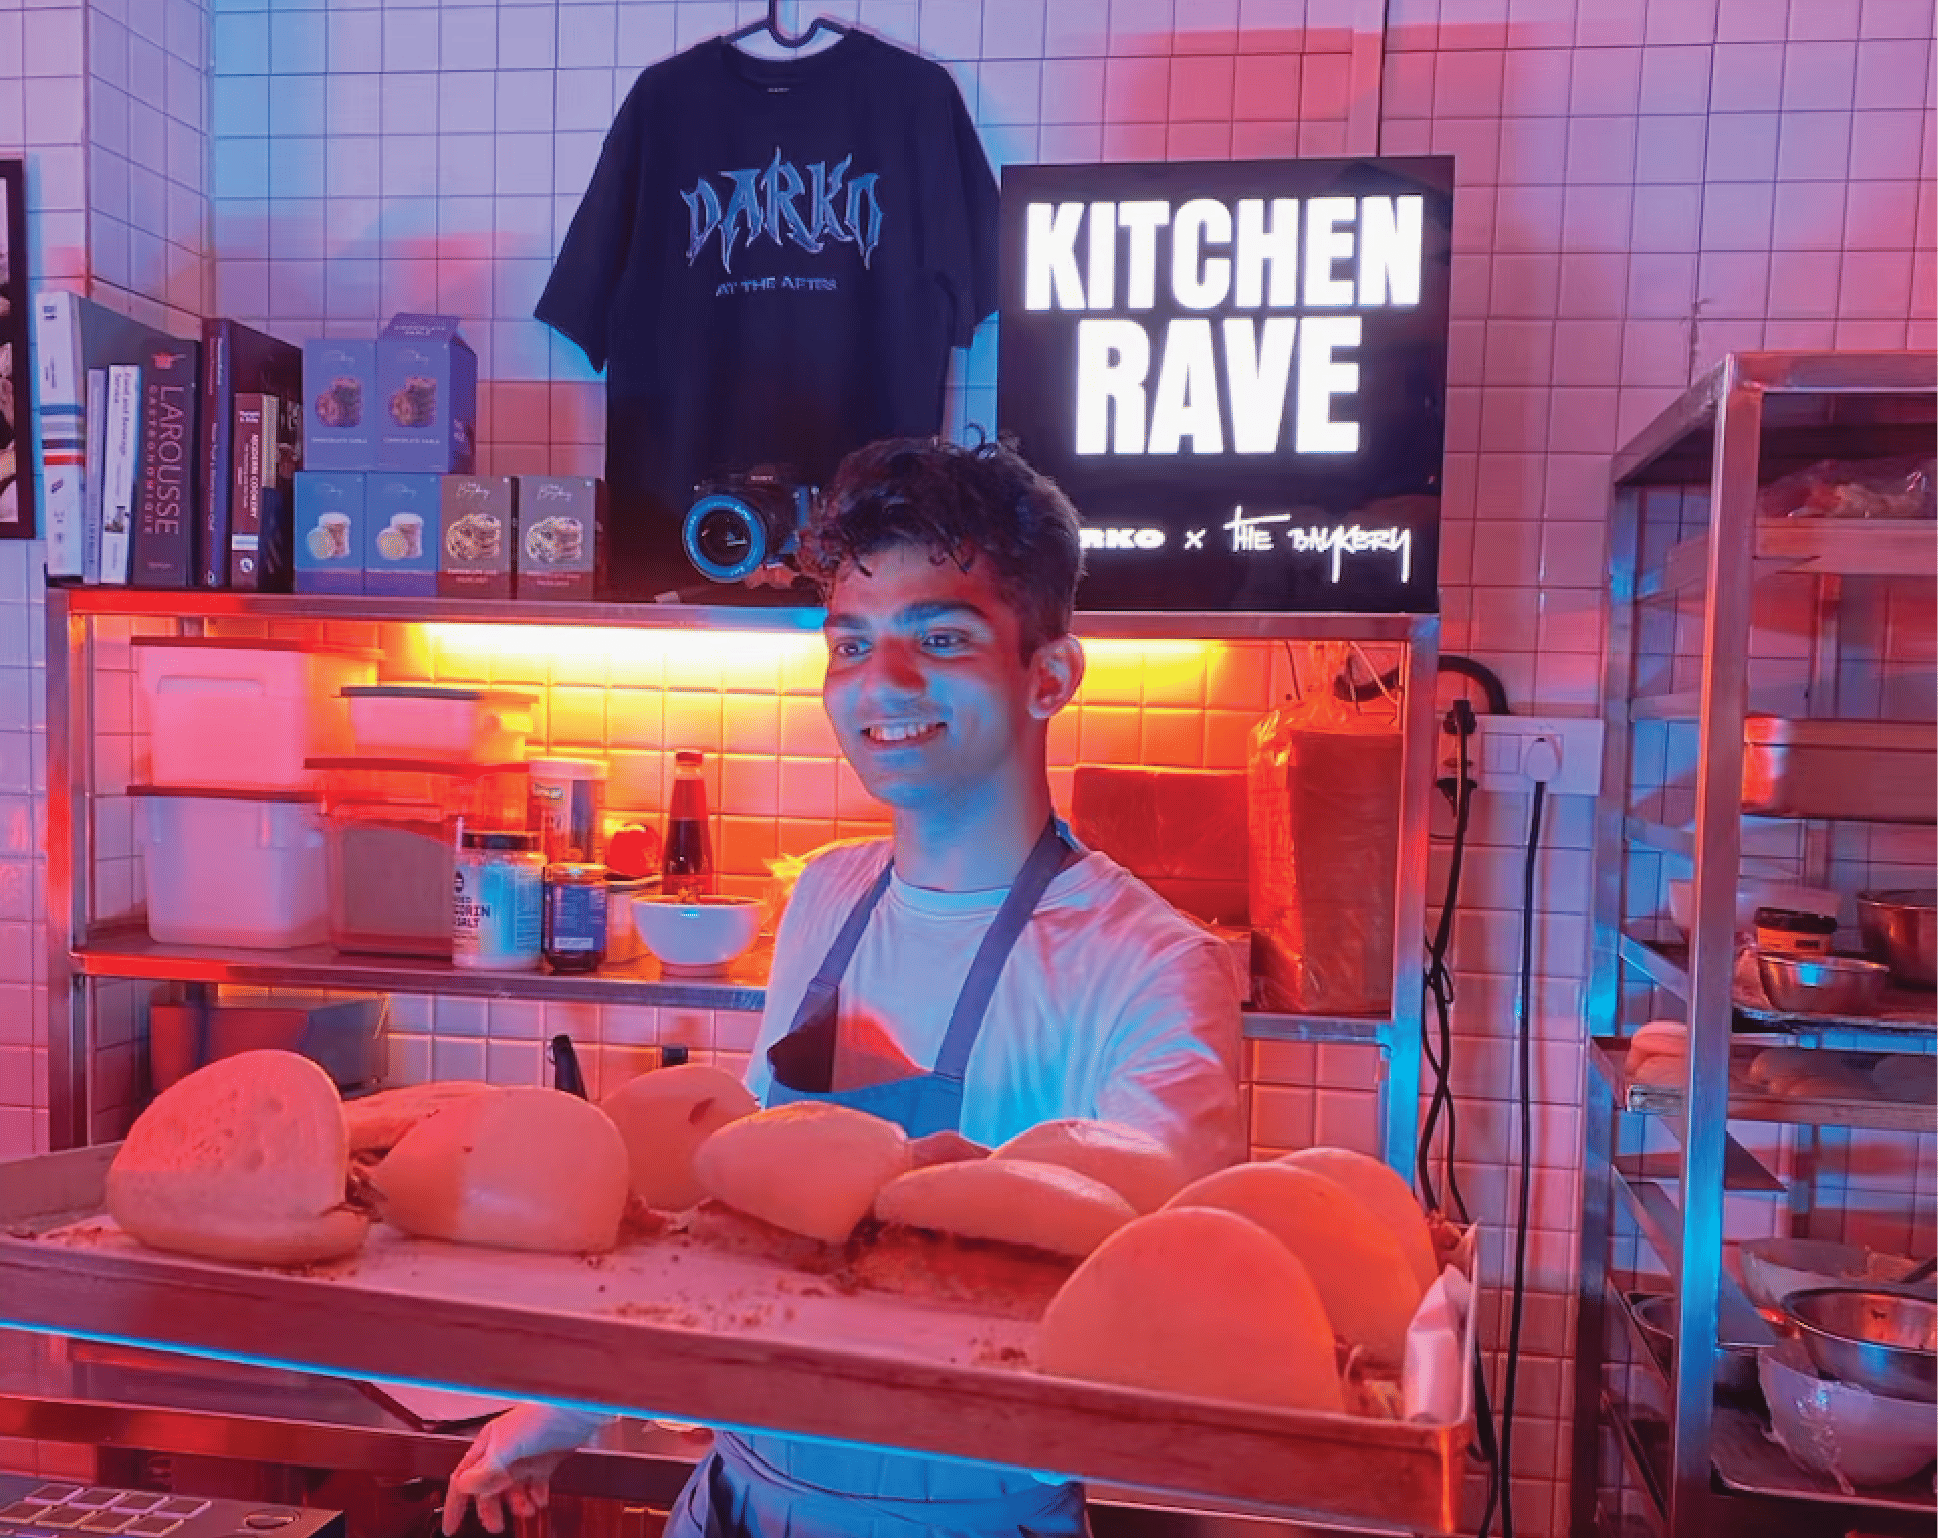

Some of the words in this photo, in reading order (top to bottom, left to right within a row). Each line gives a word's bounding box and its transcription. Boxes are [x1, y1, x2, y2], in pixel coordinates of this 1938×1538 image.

[680, 145, 883, 274] DARKO
[1025, 195, 1424, 310] KITCHEN
[741, 276, 776, 292] THE
[1075, 316, 1363, 454] RAVE
[155, 386, 185, 535] LAROUSSE
